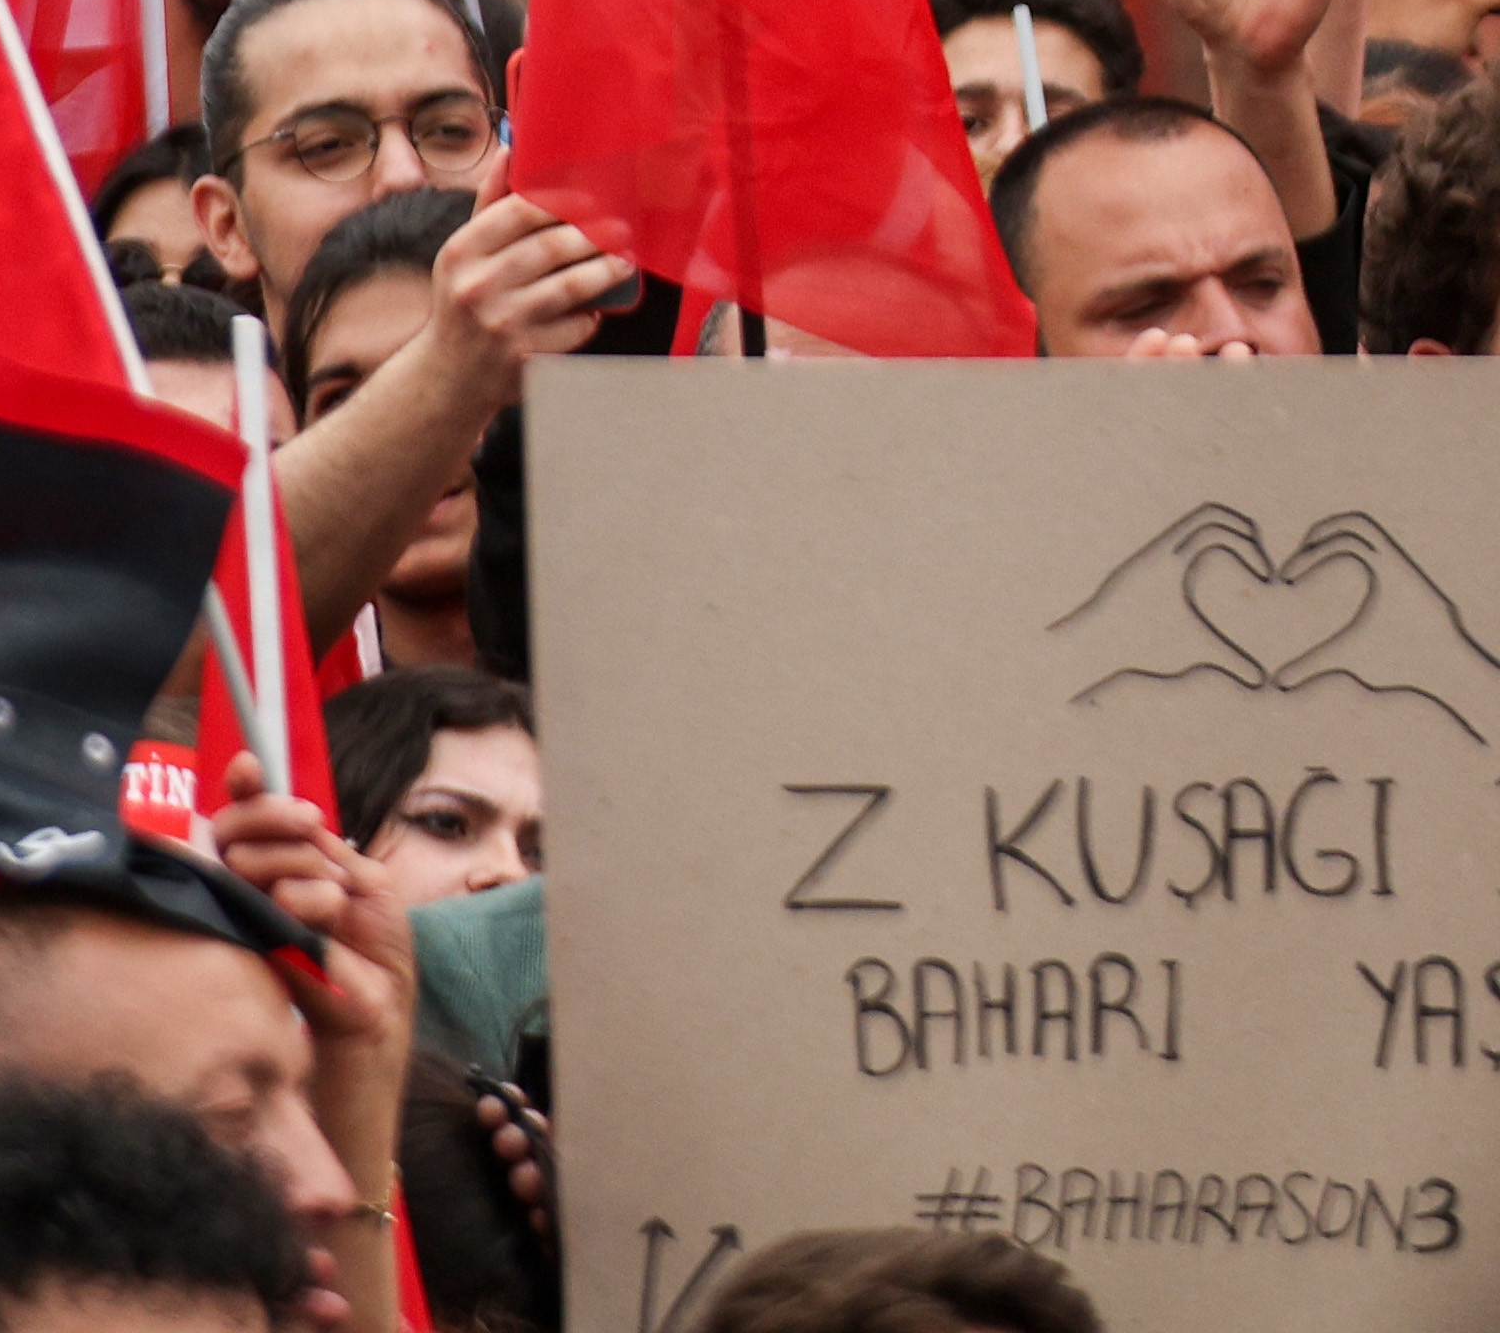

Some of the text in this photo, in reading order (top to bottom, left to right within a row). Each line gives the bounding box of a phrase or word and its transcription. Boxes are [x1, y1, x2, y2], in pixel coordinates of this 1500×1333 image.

[781, 782, 904, 910] Z
[984, 766, 1396, 912] KUŞAĞI
[845, 951, 1183, 1077] BAHARI
